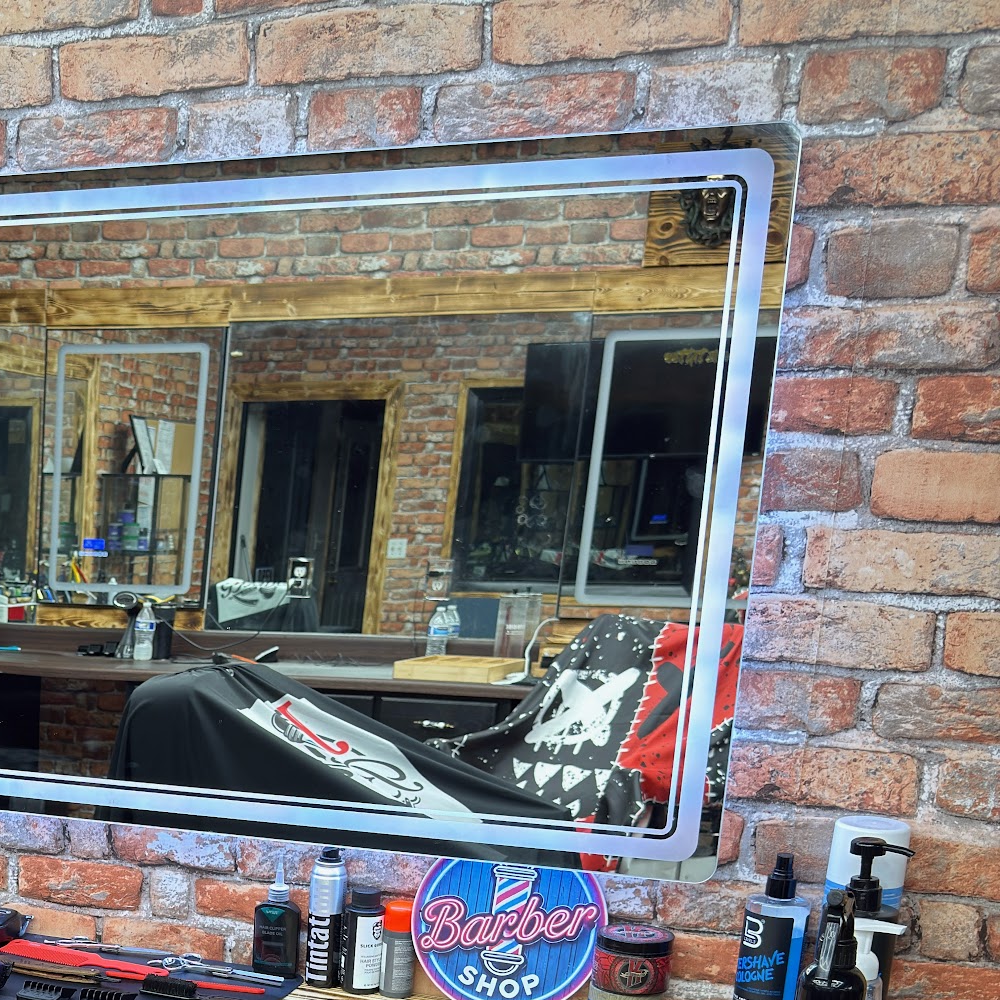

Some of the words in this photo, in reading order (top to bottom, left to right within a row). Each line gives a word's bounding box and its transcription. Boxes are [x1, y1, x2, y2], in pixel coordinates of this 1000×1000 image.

[420, 895, 598, 950] Barber
[306, 911, 331, 982] Tintat
[738, 950, 785, 969] ERSHAVE
[457, 965, 540, 999] SHOP
